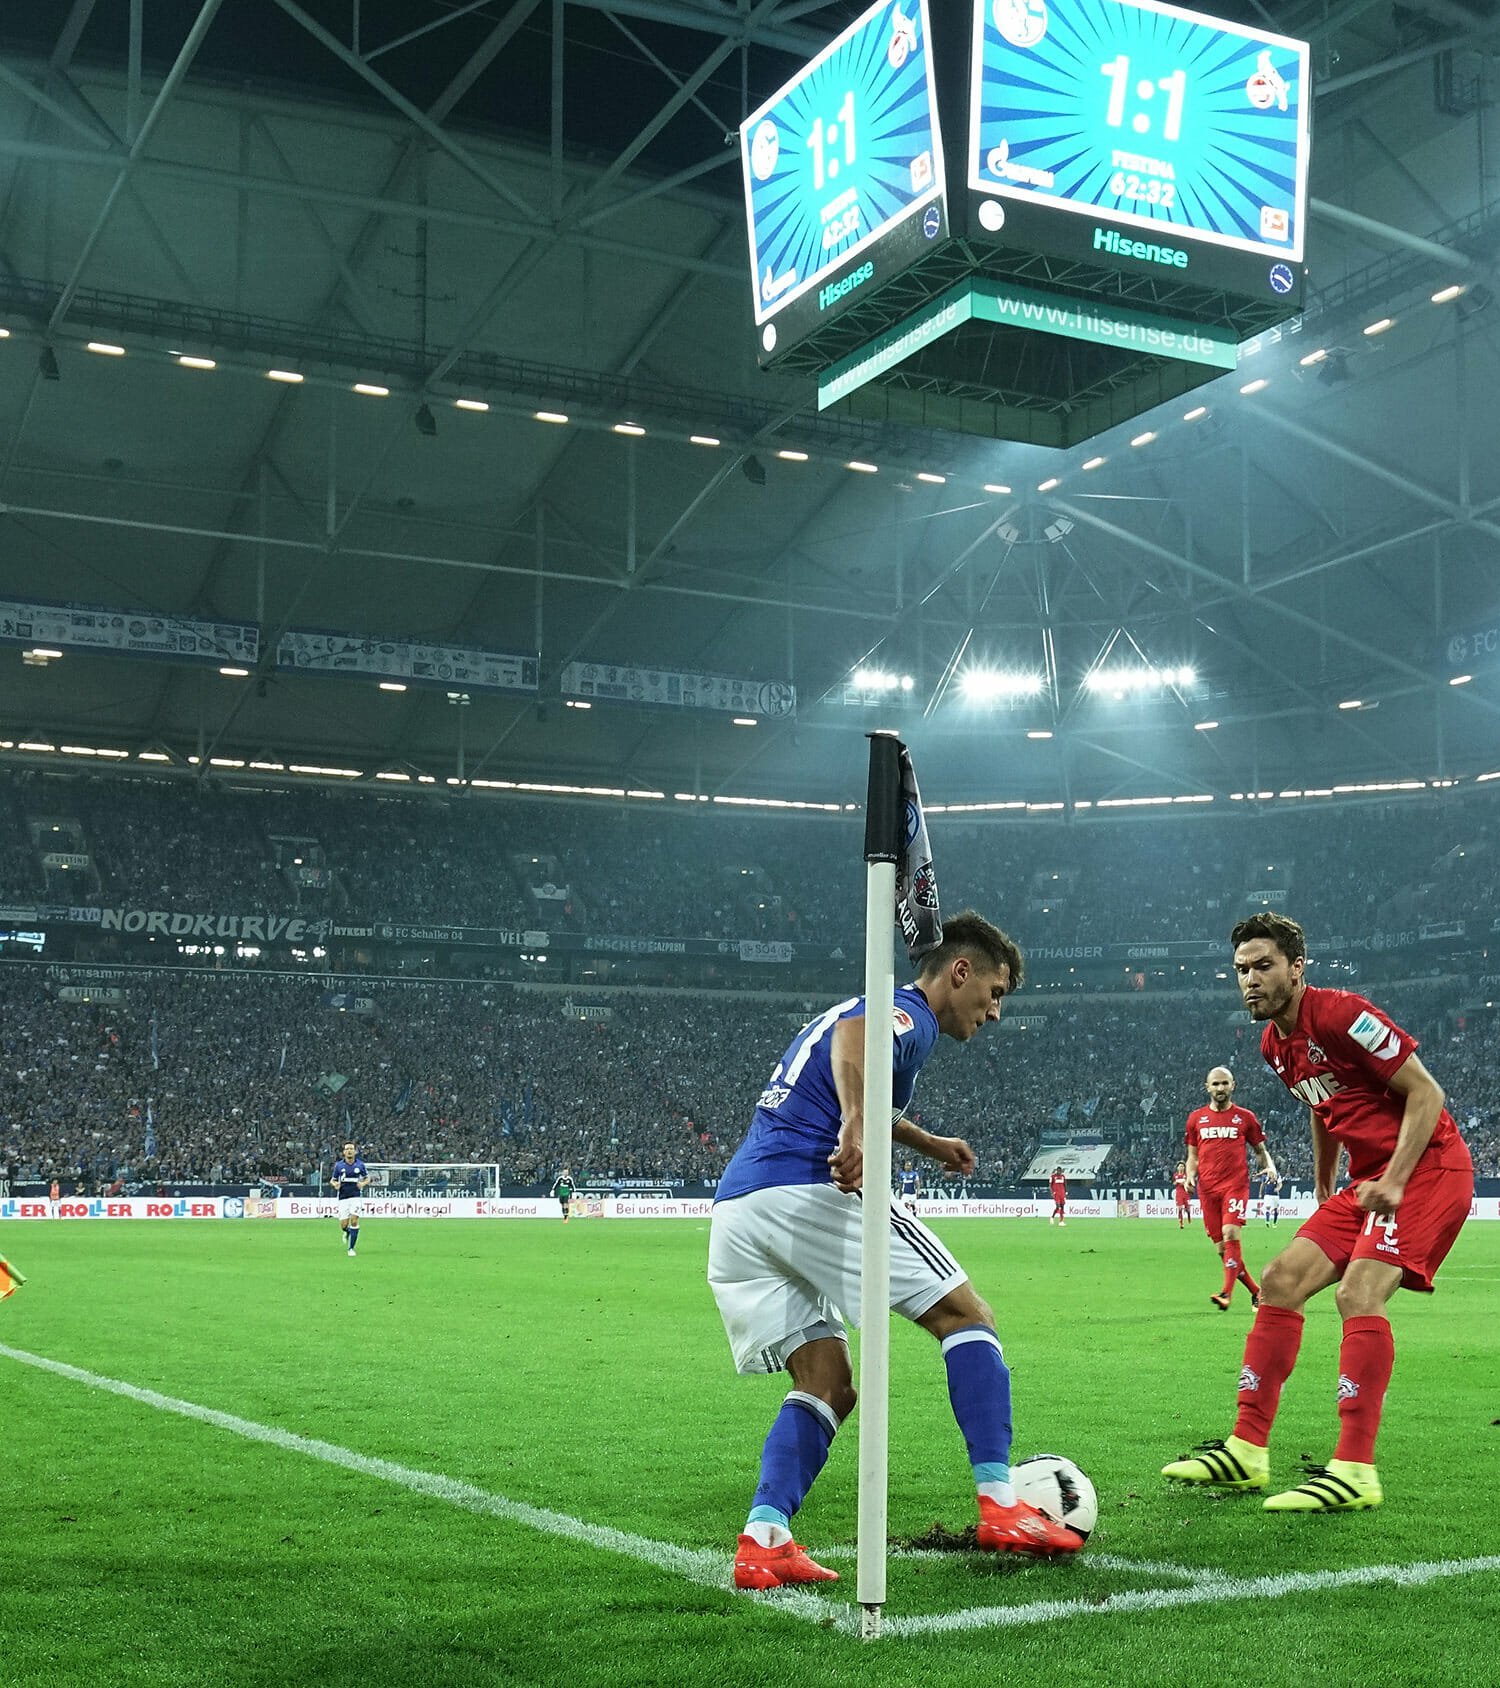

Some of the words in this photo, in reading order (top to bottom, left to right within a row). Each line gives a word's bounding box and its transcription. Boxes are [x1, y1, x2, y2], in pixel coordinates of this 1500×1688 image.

[1101, 54, 1186, 141] 1:1
[806, 91, 857, 190] 1:1
[1110, 172, 1174, 207] 62:32
[1093, 228, 1188, 268] Hisense
[819, 260, 874, 311] Hisense
[997, 296, 1215, 356] www.hisense.de
[830, 299, 957, 394] www.hisense.de
[101, 908, 306, 941] NORDKURVE
[396, 928, 408, 938] FC
[411, 929, 448, 940] Schalke
[451, 931, 462, 940] 04
[1200, 1127, 1239, 1140] REWE
[369, 1188, 413, 1199] lksbank
[61, 1200, 132, 1217] ROLLER
[147, 1200, 215, 1217] ROLLER
[291, 1203, 311, 1215] Bei
[316, 1205, 339, 1215] uns
[491, 1206, 537, 1215] Kaufland
[616, 1203, 635, 1214] Bei
[639, 1206, 659, 1214] uns
[662, 1203, 677, 1214] im
[925, 1206, 943, 1215] uns
[946, 1203, 958, 1214] im
[962, 1203, 1034, 1218] Tiefkühlregal
[1069, 1206, 1101, 1216] Kaufland
[1146, 1204, 1158, 1215] Bei
[1228, 1198, 1244, 1213] 34
[1364, 1209, 1398, 1236] 14
